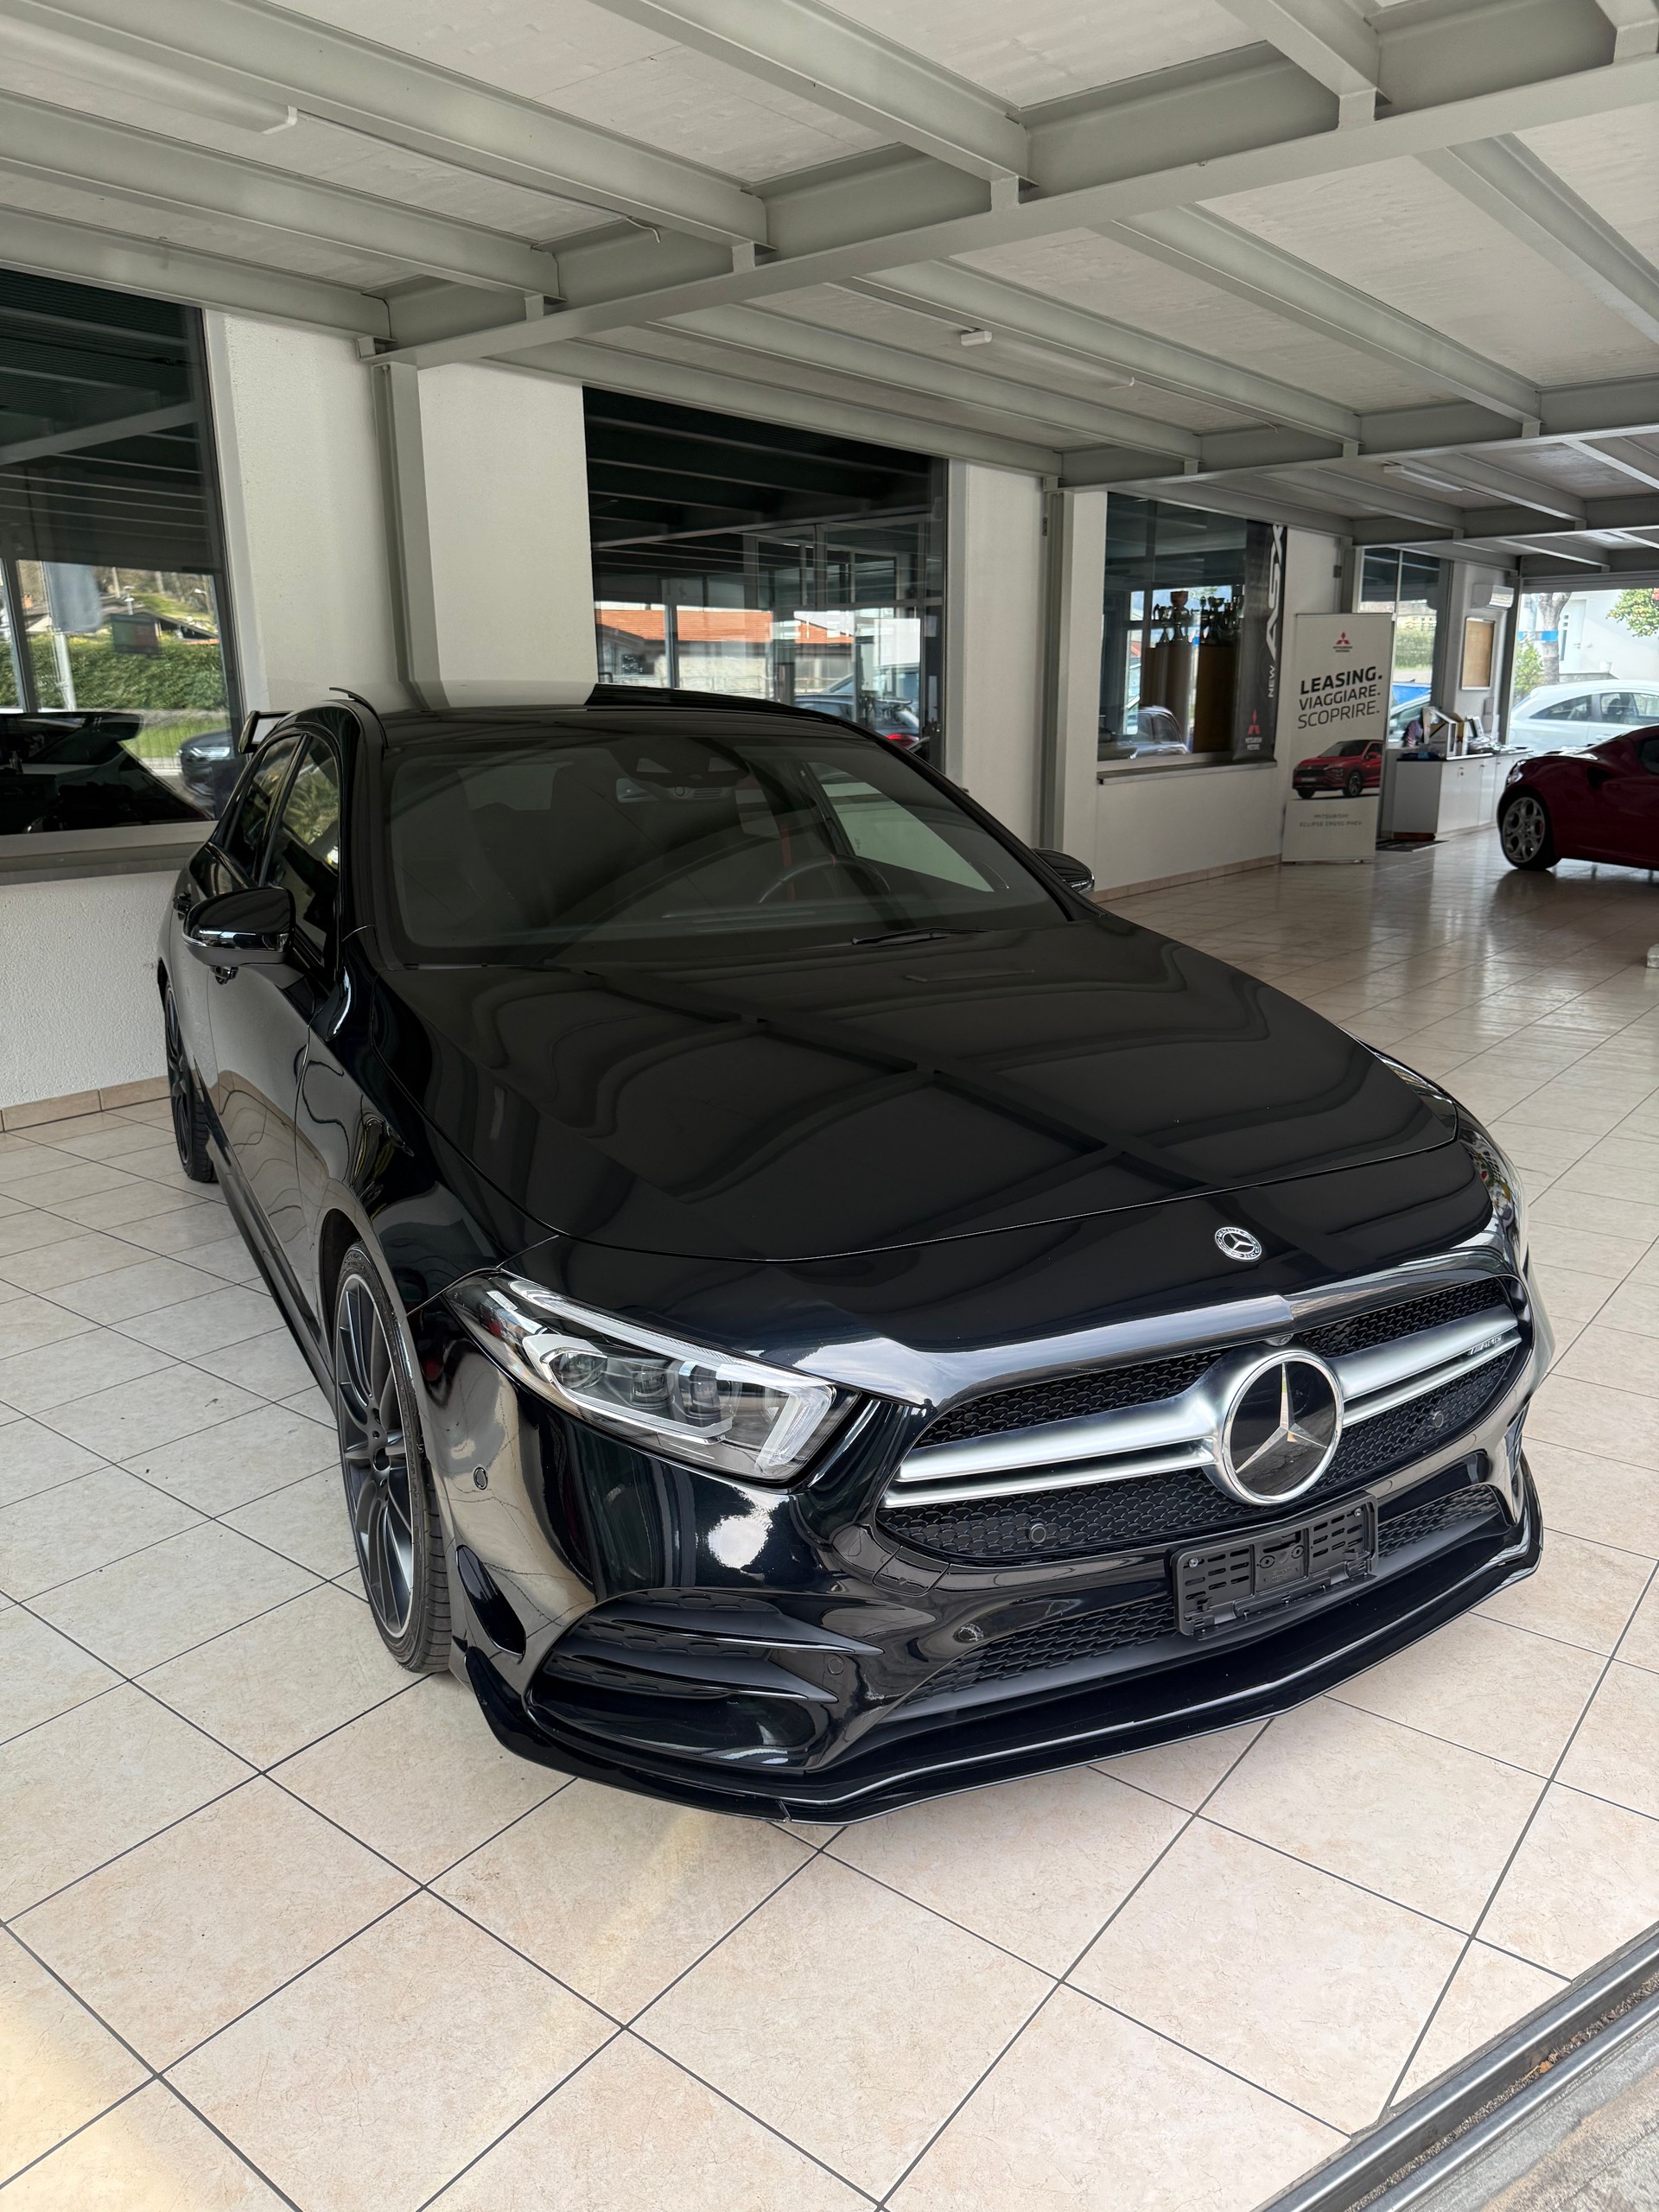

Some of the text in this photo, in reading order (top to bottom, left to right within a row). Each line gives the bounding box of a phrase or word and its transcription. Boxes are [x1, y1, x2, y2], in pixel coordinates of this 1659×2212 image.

[1300, 665, 1382, 695] LEASING.
[1299, 684, 1381, 711] VIAGGIARE.
[1297, 700, 1380, 729] SCOPRIRE.
